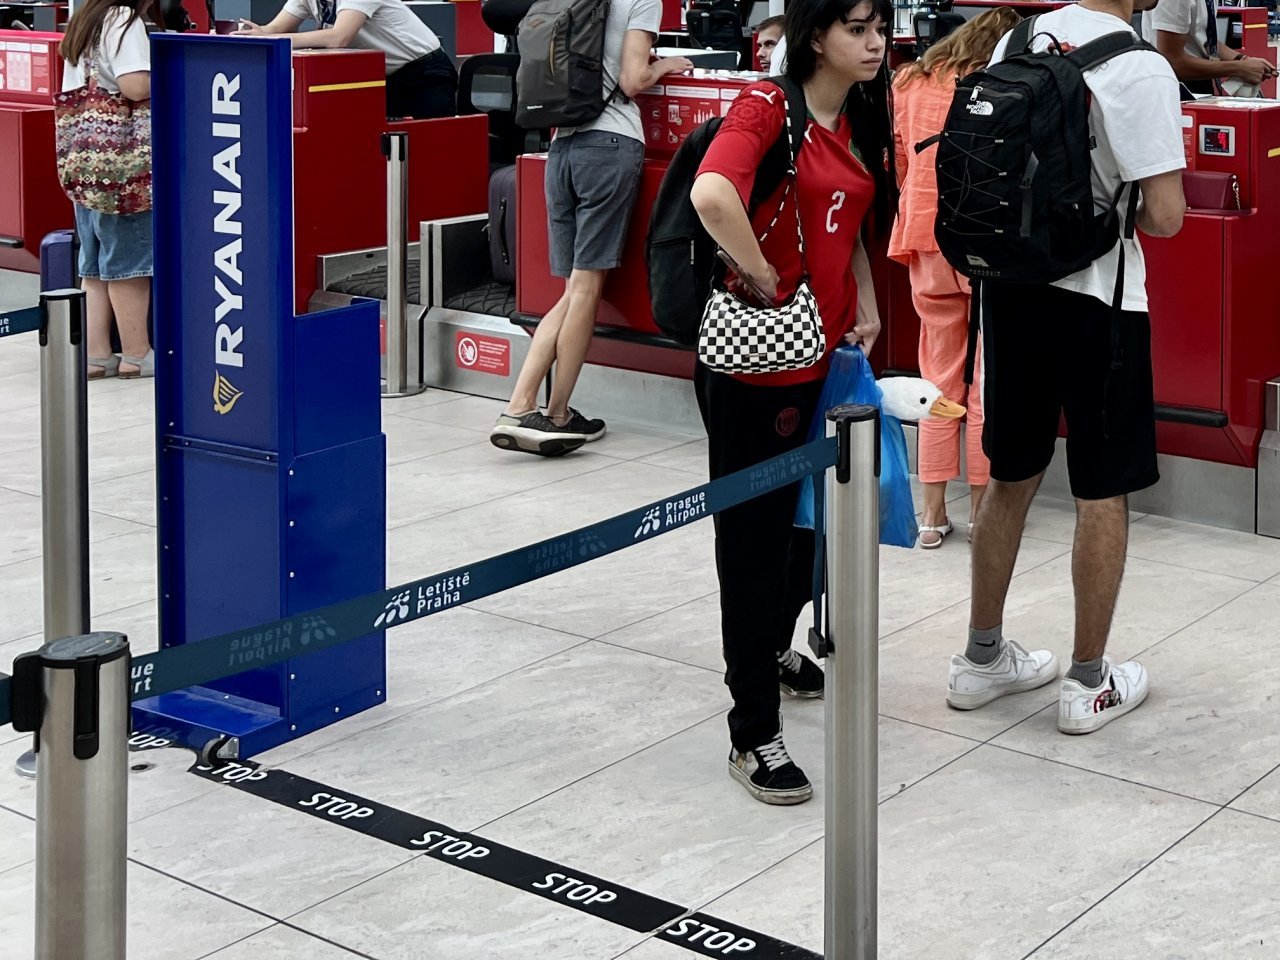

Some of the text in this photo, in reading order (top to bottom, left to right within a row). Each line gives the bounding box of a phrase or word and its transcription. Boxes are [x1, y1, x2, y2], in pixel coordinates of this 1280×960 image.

[211, 72, 244, 368] RYANAIR
[826, 190, 846, 233] 2
[665, 491, 705, 514] Prague
[665, 501, 706, 527] Airport
[417, 572, 470, 599] Letiště
[416, 591, 460, 613] Praha
[299, 792, 374, 822] STOP
[410, 830, 490, 862] STOP
[532, 872, 617, 908] STOP
[666, 918, 756, 956] STOP
